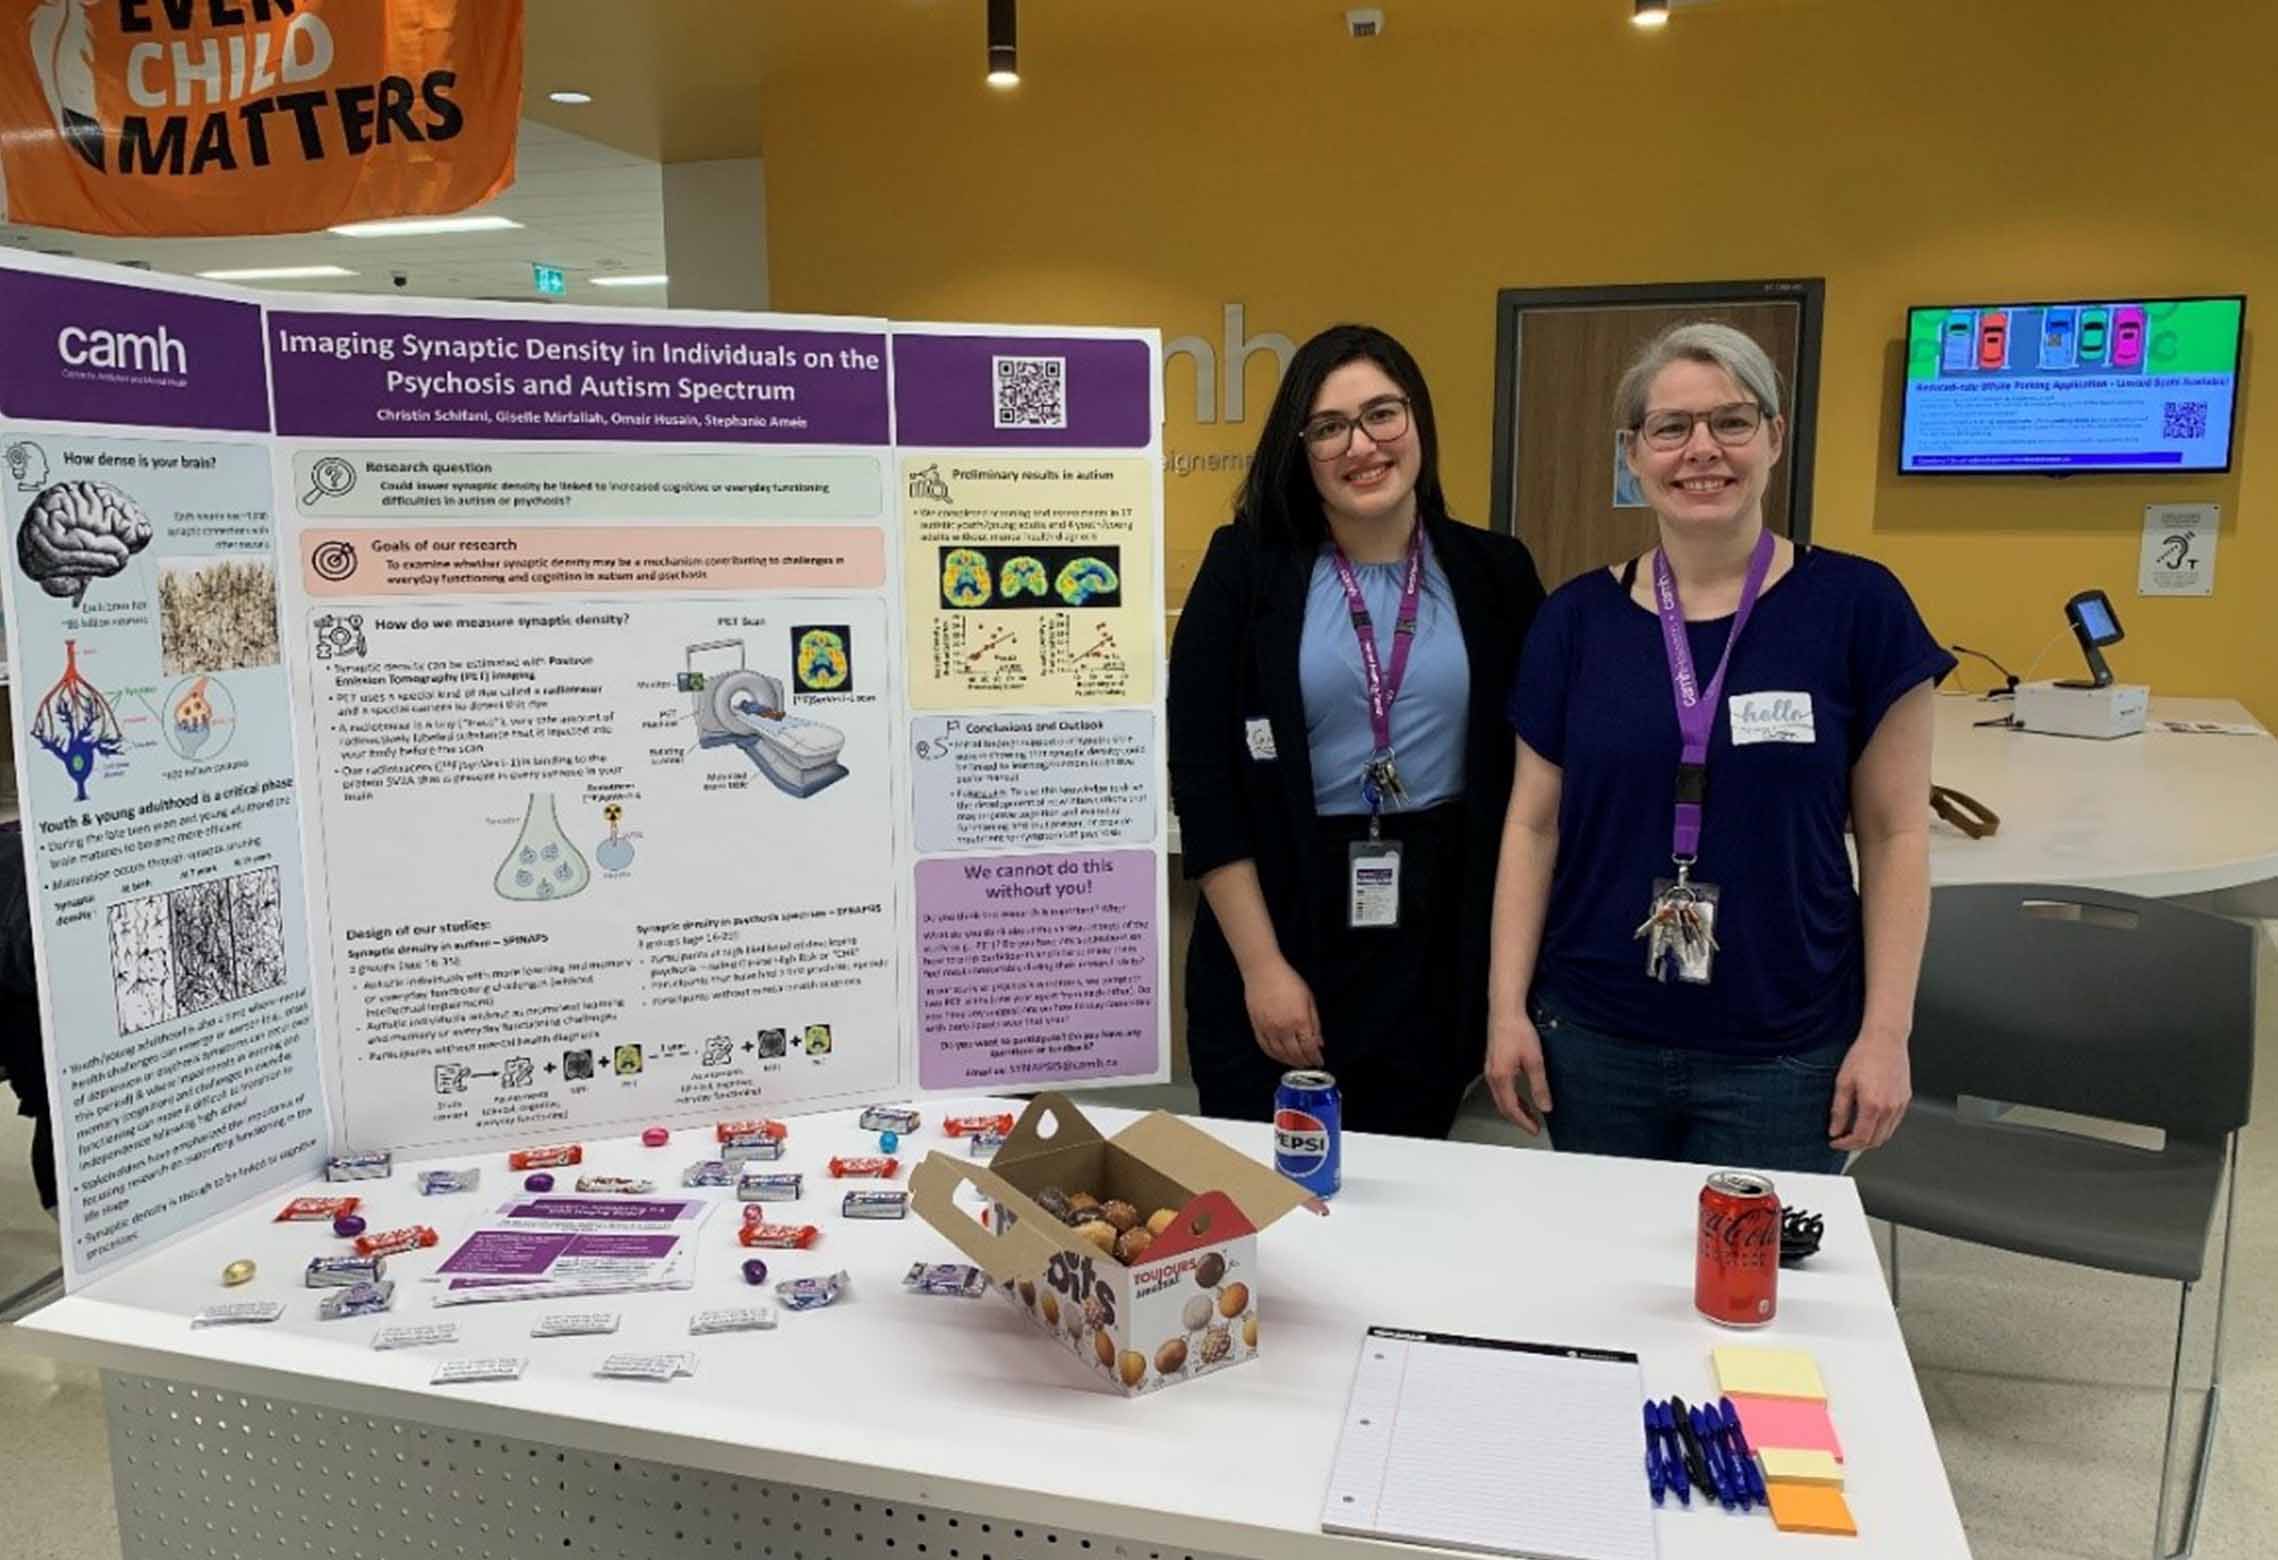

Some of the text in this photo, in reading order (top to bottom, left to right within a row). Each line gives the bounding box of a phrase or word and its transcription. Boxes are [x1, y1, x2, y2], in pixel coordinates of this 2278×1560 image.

[127, 12, 334, 108] CHILD
[118, 70, 464, 177] MATTERS
[58, 325, 187, 374] camh
[280, 331, 879, 369] Imaging Synaptic Density in Individuals on the
[386, 371, 795, 401] Psychosis and Autism Spectrum
[376, 409, 430, 420] Christin
[63, 451, 216, 469] How dense is your brain?
[365, 462, 492, 474] Research question
[370, 539, 517, 552] Goals of our research
[374, 613, 629, 629] How do we measure synaptic density?
[964, 858, 1113, 879] We cannot do this
[985, 879, 1092, 898] without you!
[345, 920, 490, 940] Design of our studies:
